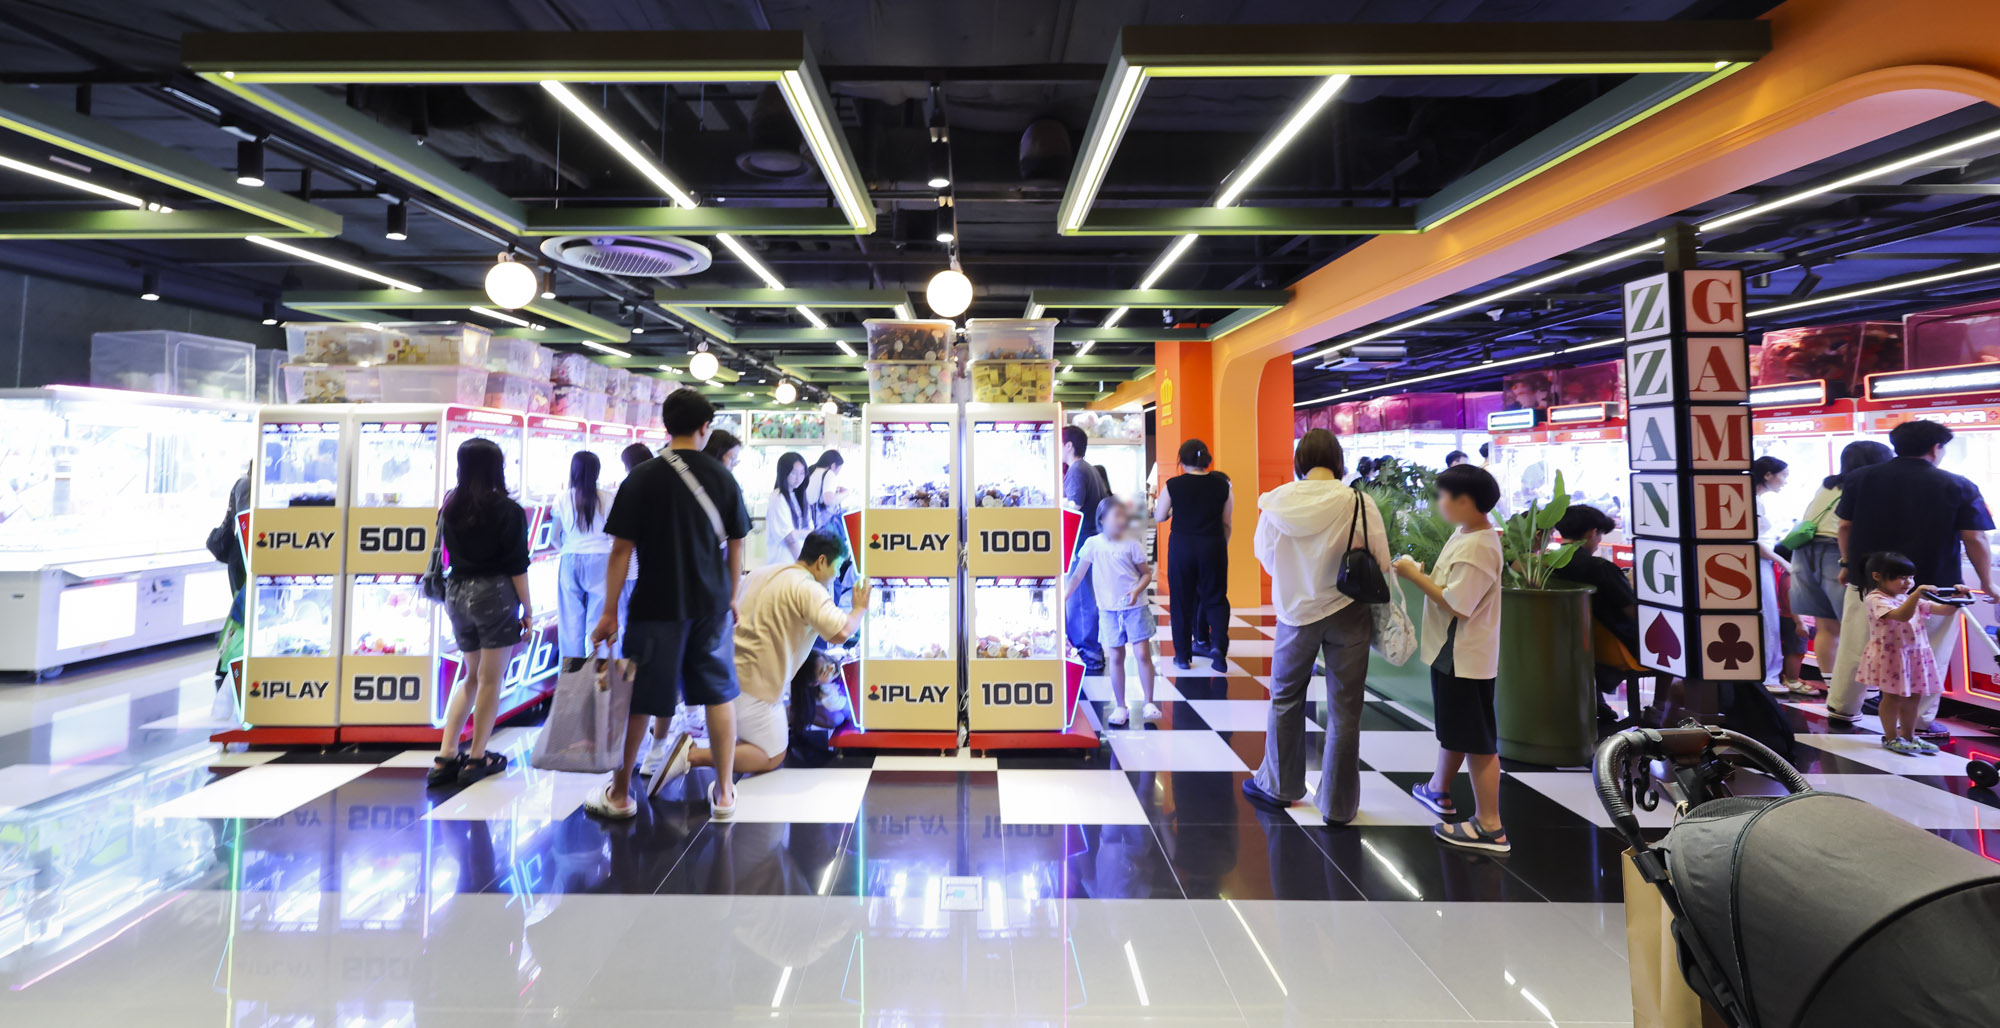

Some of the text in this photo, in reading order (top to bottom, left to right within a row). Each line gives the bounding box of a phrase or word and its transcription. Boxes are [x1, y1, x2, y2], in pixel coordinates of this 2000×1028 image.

[1630, 282, 1677, 597] ZZANG
[1688, 277, 1753, 601] GAMES
[268, 531, 336, 550] 1PLAY
[359, 526, 427, 552] 500
[881, 533, 951, 551] 1PLAY
[979, 530, 1052, 553] 1000
[262, 680, 330, 699] 1PLAY
[353, 675, 421, 702] 500
[880, 684, 950, 703] 1PLAY
[981, 682, 1054, 706] 1000
